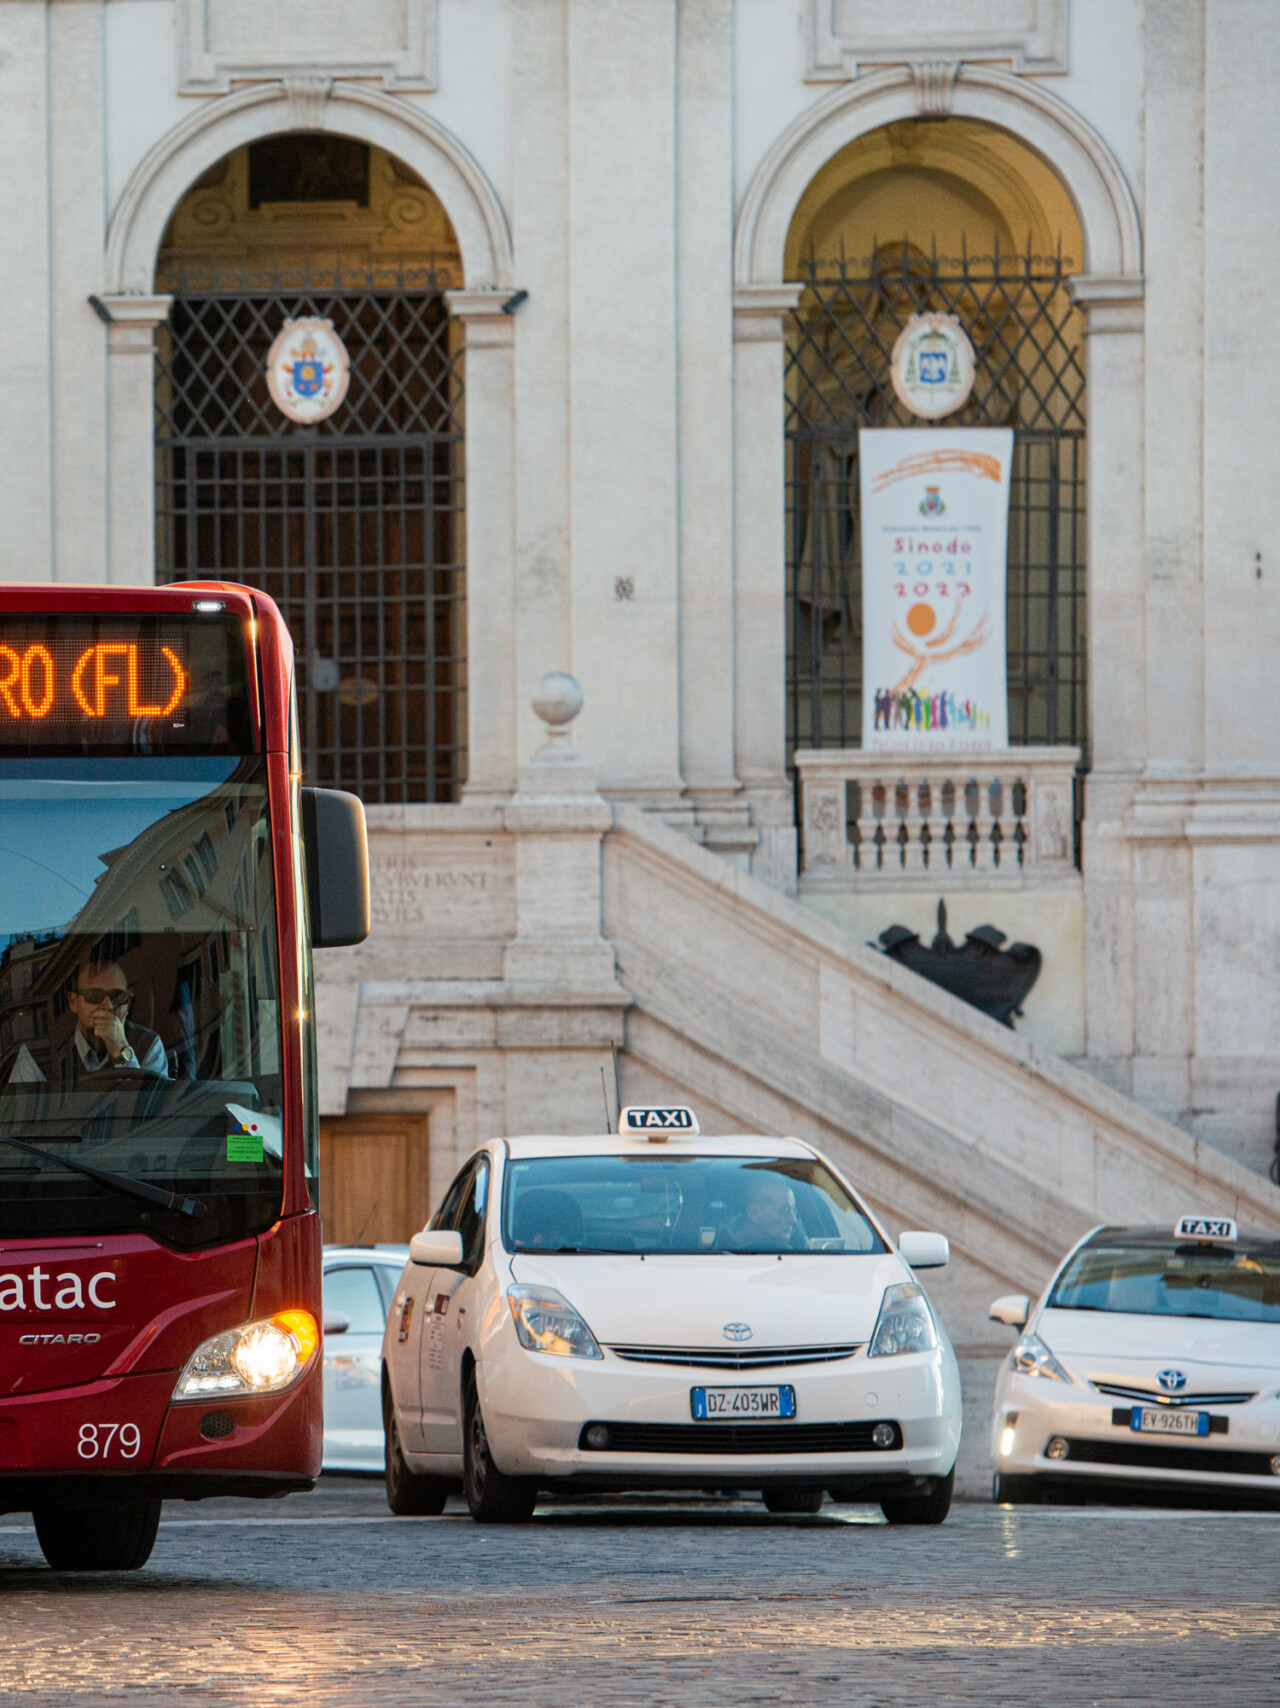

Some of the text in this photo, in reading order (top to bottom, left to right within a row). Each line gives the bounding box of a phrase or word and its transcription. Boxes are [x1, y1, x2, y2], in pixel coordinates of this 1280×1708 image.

[894, 537, 972, 554] Sinodo
[893, 561, 972, 576] 2021
[893, 581, 972, 598] 2023
[72, 644, 185, 717] (FL)
[629, 1111, 688, 1126] TAXI
[1183, 1221, 1228, 1236] TAXI
[19, 1333, 101, 1345] CITARO
[77, 1423, 141, 1459] 879
